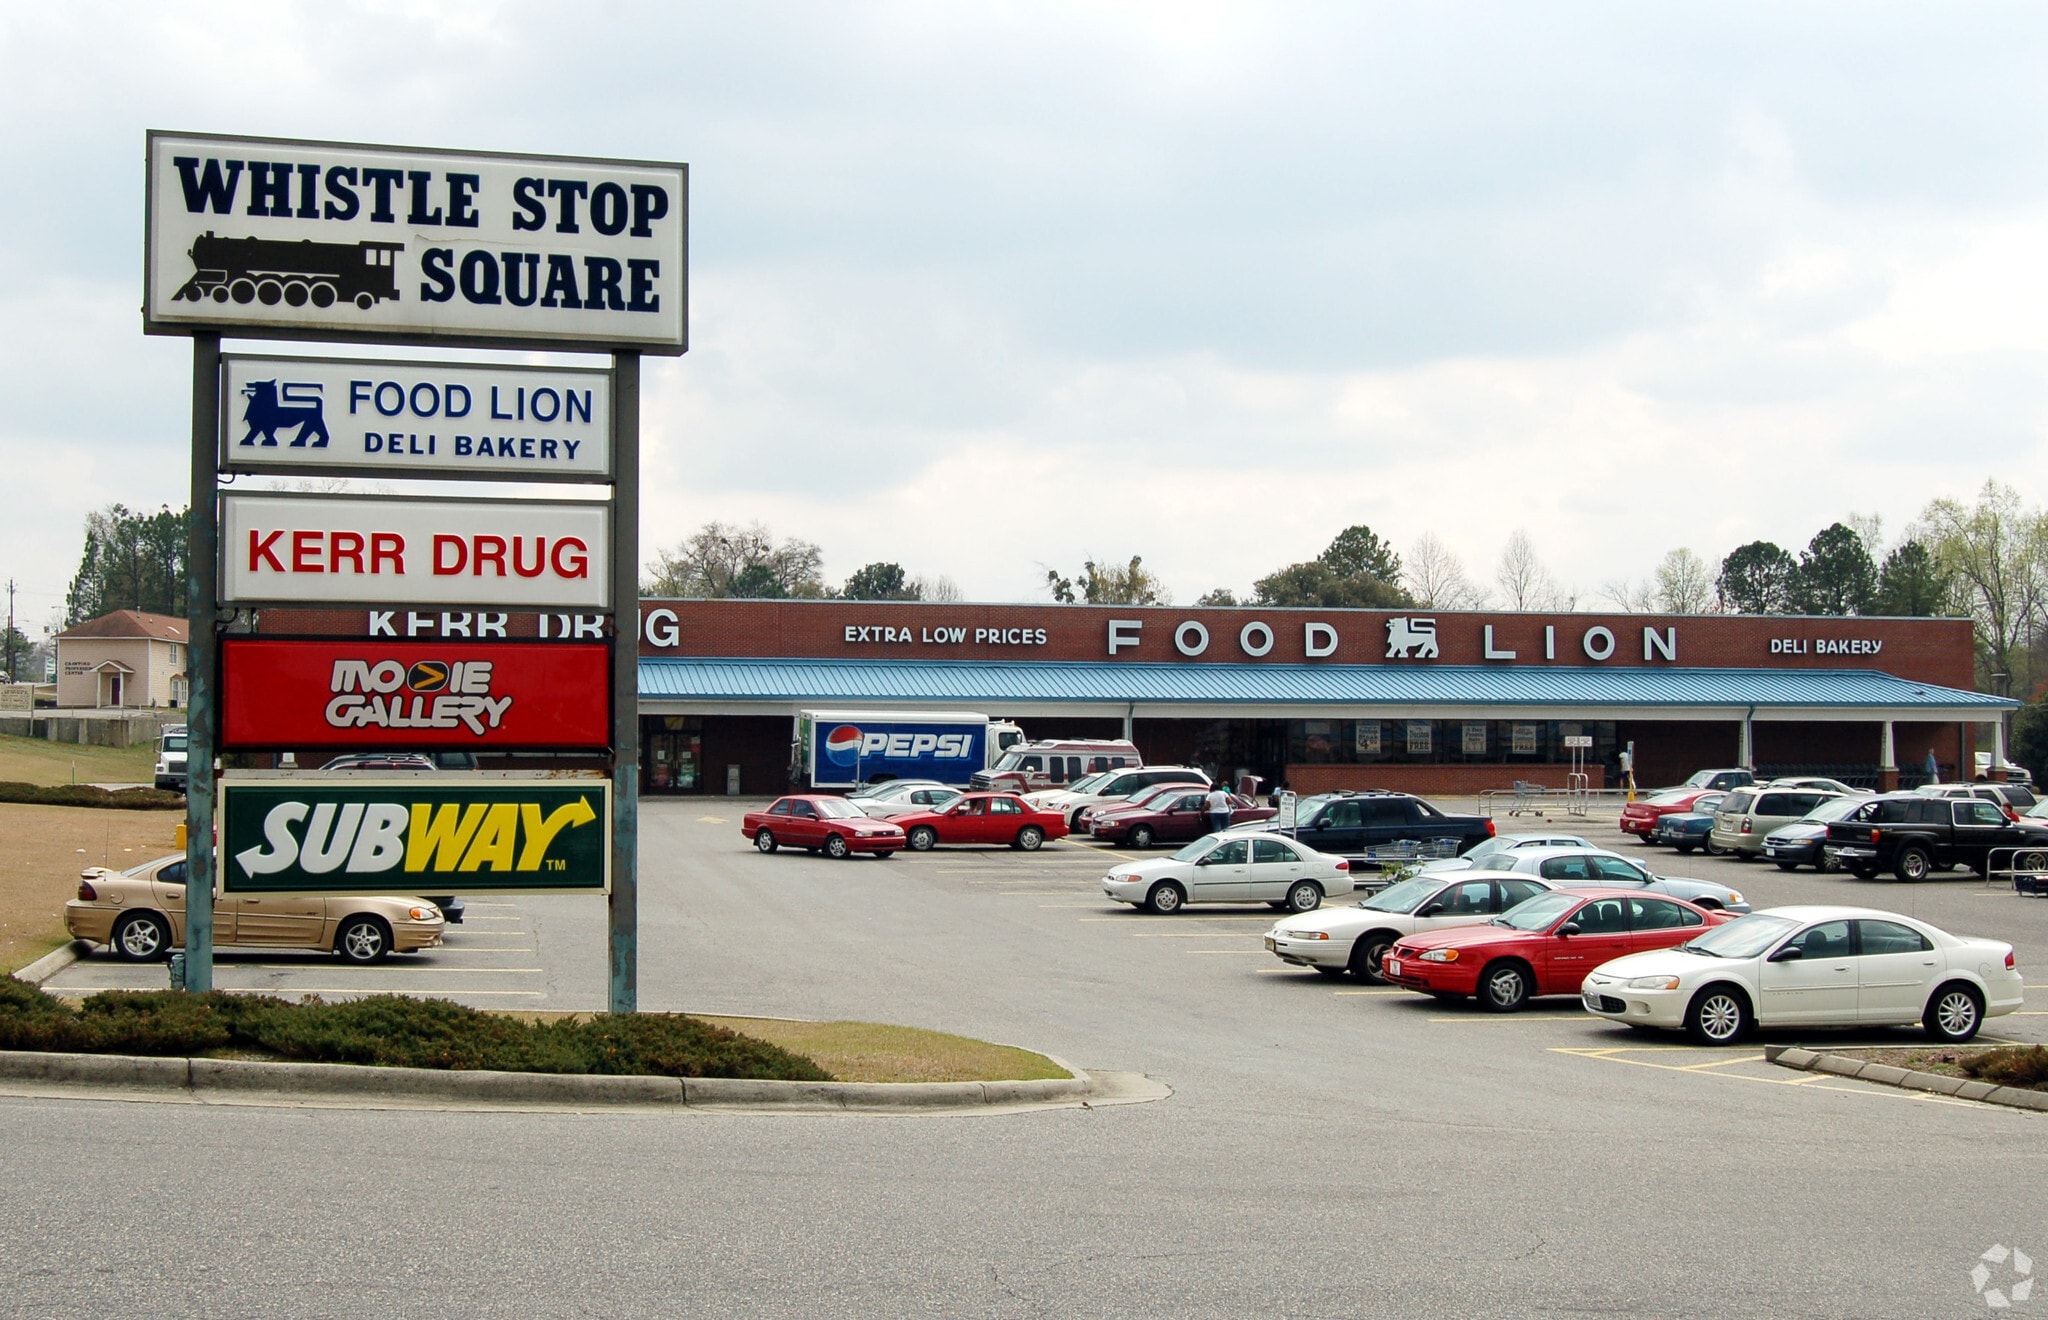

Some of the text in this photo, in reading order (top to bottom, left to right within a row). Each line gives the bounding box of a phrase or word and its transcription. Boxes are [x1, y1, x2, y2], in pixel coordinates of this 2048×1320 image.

[173, 155, 669, 238] WHISTLE STOP
[420, 247, 660, 313] SQUARE
[349, 380, 592, 424] FOOD LION
[364, 432, 581, 460] DELI BAKERY
[248, 529, 589, 579] KERR DRUG
[369, 608, 680, 647] KERR DRG
[845, 626, 1047, 645] EXTRA LOW PRICES
[1108, 619, 1677, 661] FOOD LION
[1770, 638, 1883, 655] DELI BAKERY
[325, 694, 512, 735] GALLERY
[860, 732, 974, 759] PEPSI
[235, 795, 596, 879] SUBWAY TM
